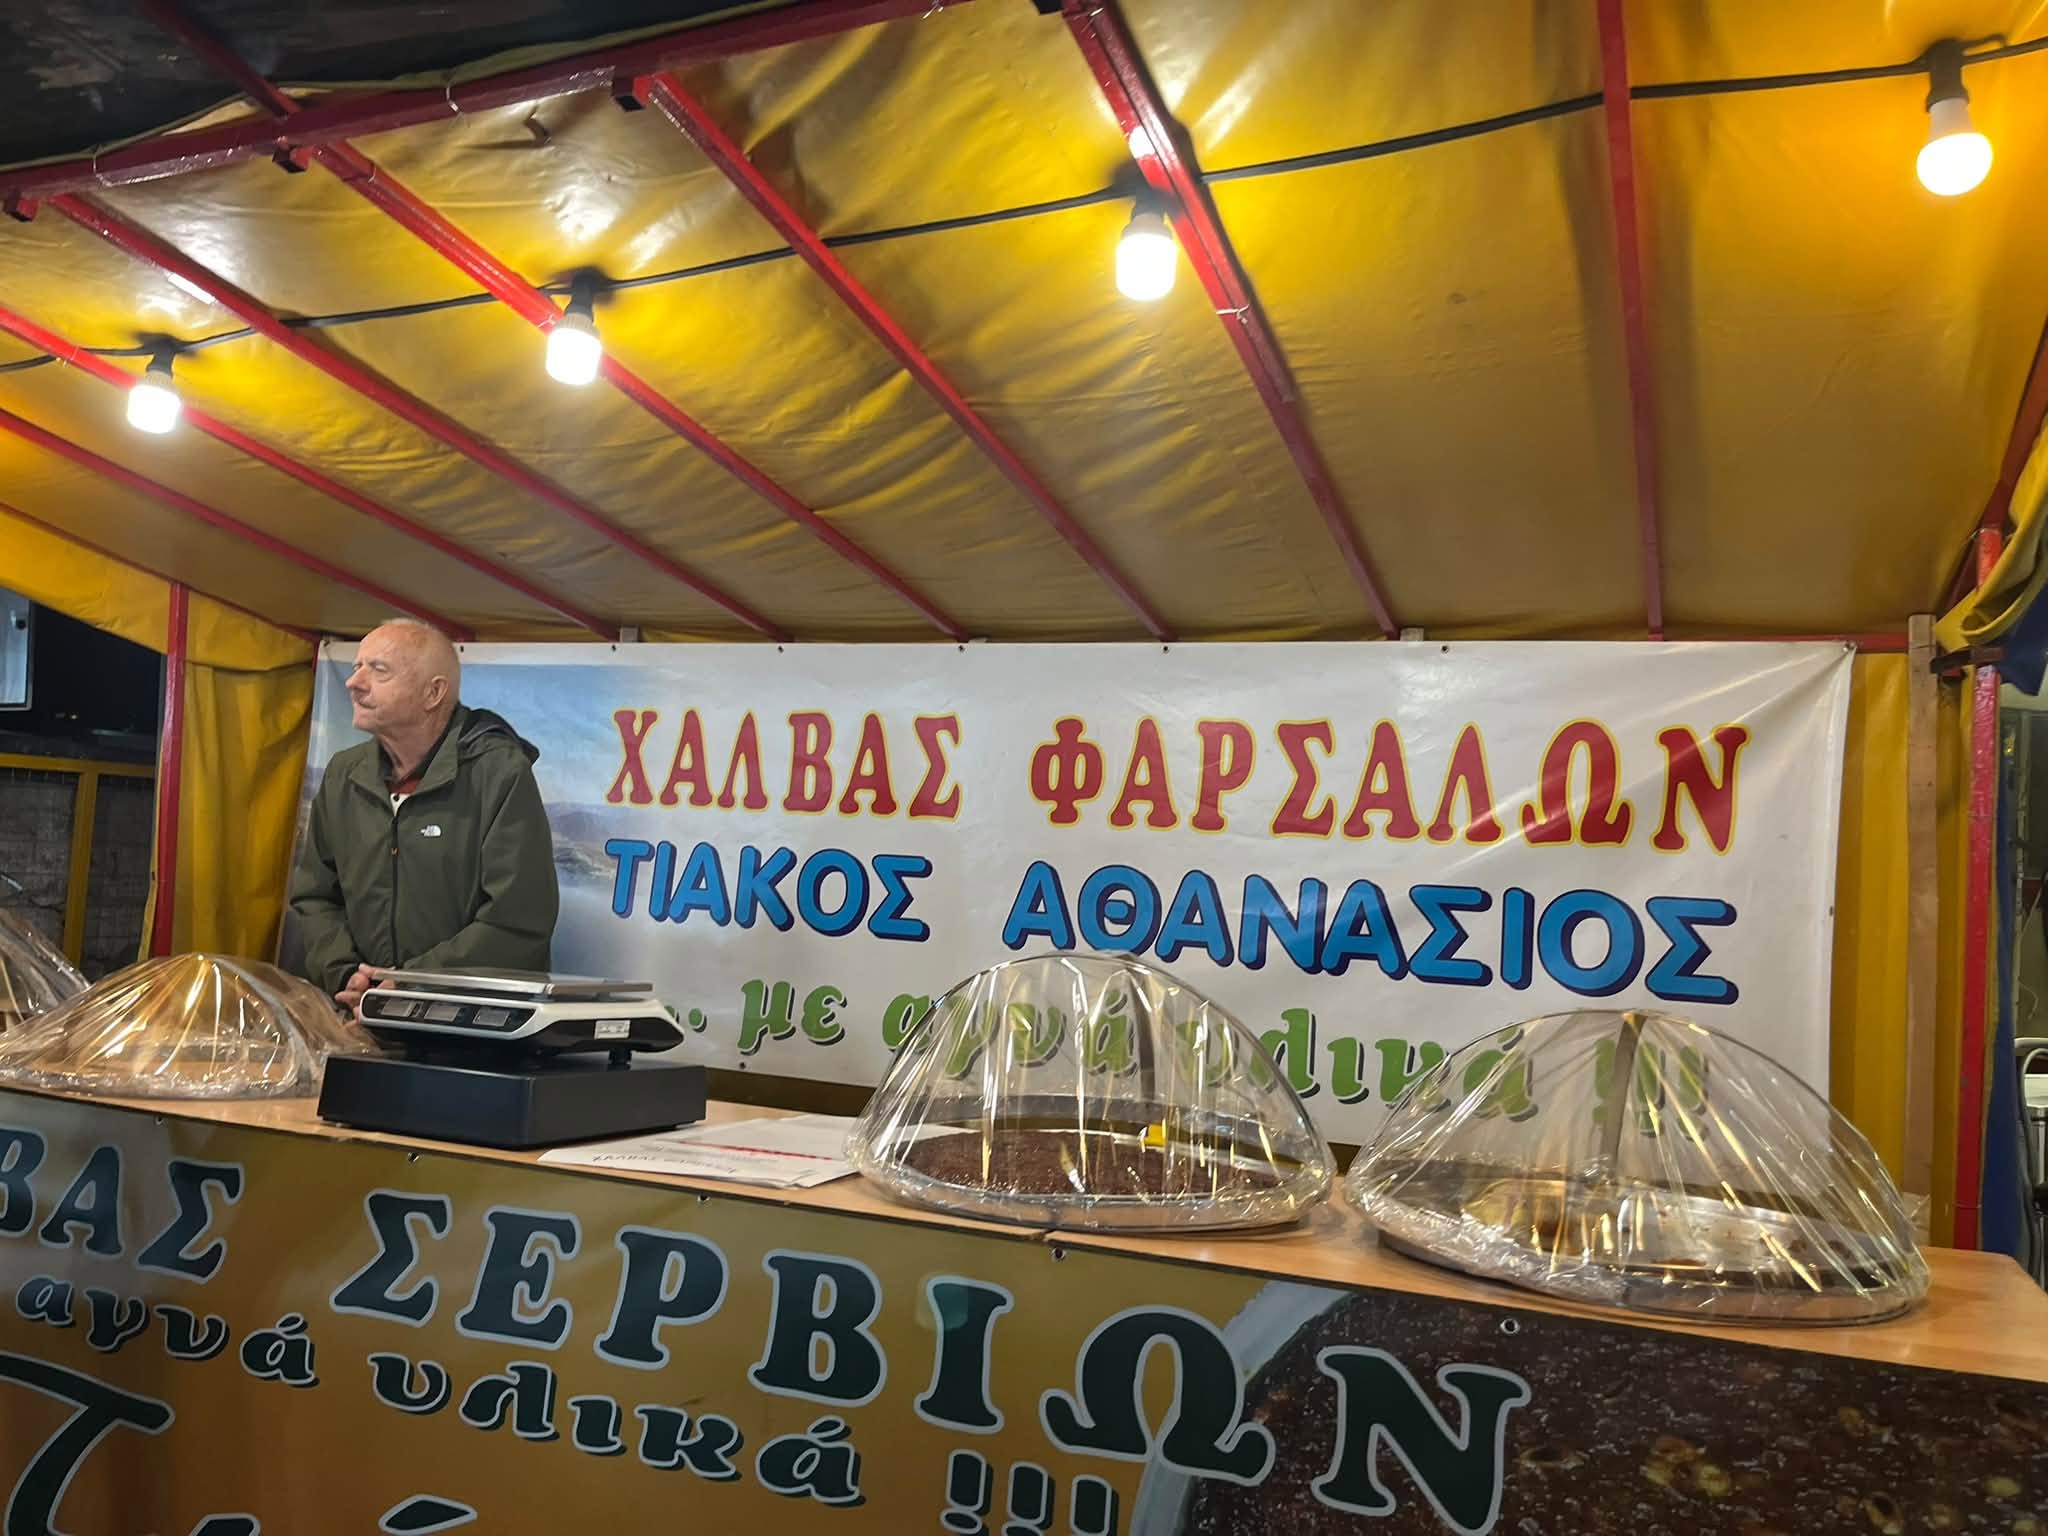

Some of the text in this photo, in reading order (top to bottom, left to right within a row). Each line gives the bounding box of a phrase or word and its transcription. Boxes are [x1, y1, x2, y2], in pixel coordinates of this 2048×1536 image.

[605, 708, 1752, 856] ΧΑΛΒΑΣ ΦΑΡΣΑΛΩΝ
[604, 837, 1739, 1006] ΤΙΑΚΟΣ ΑΘΑΝΑΣΙΟΣ
[738, 978, 848, 1054] με
[16, 1275, 319, 1388] αγνά
[367, 1352, 867, 1508] υλικά
[329, 1188, 1532, 1536] ΣΕΡΒΙΩΝ
